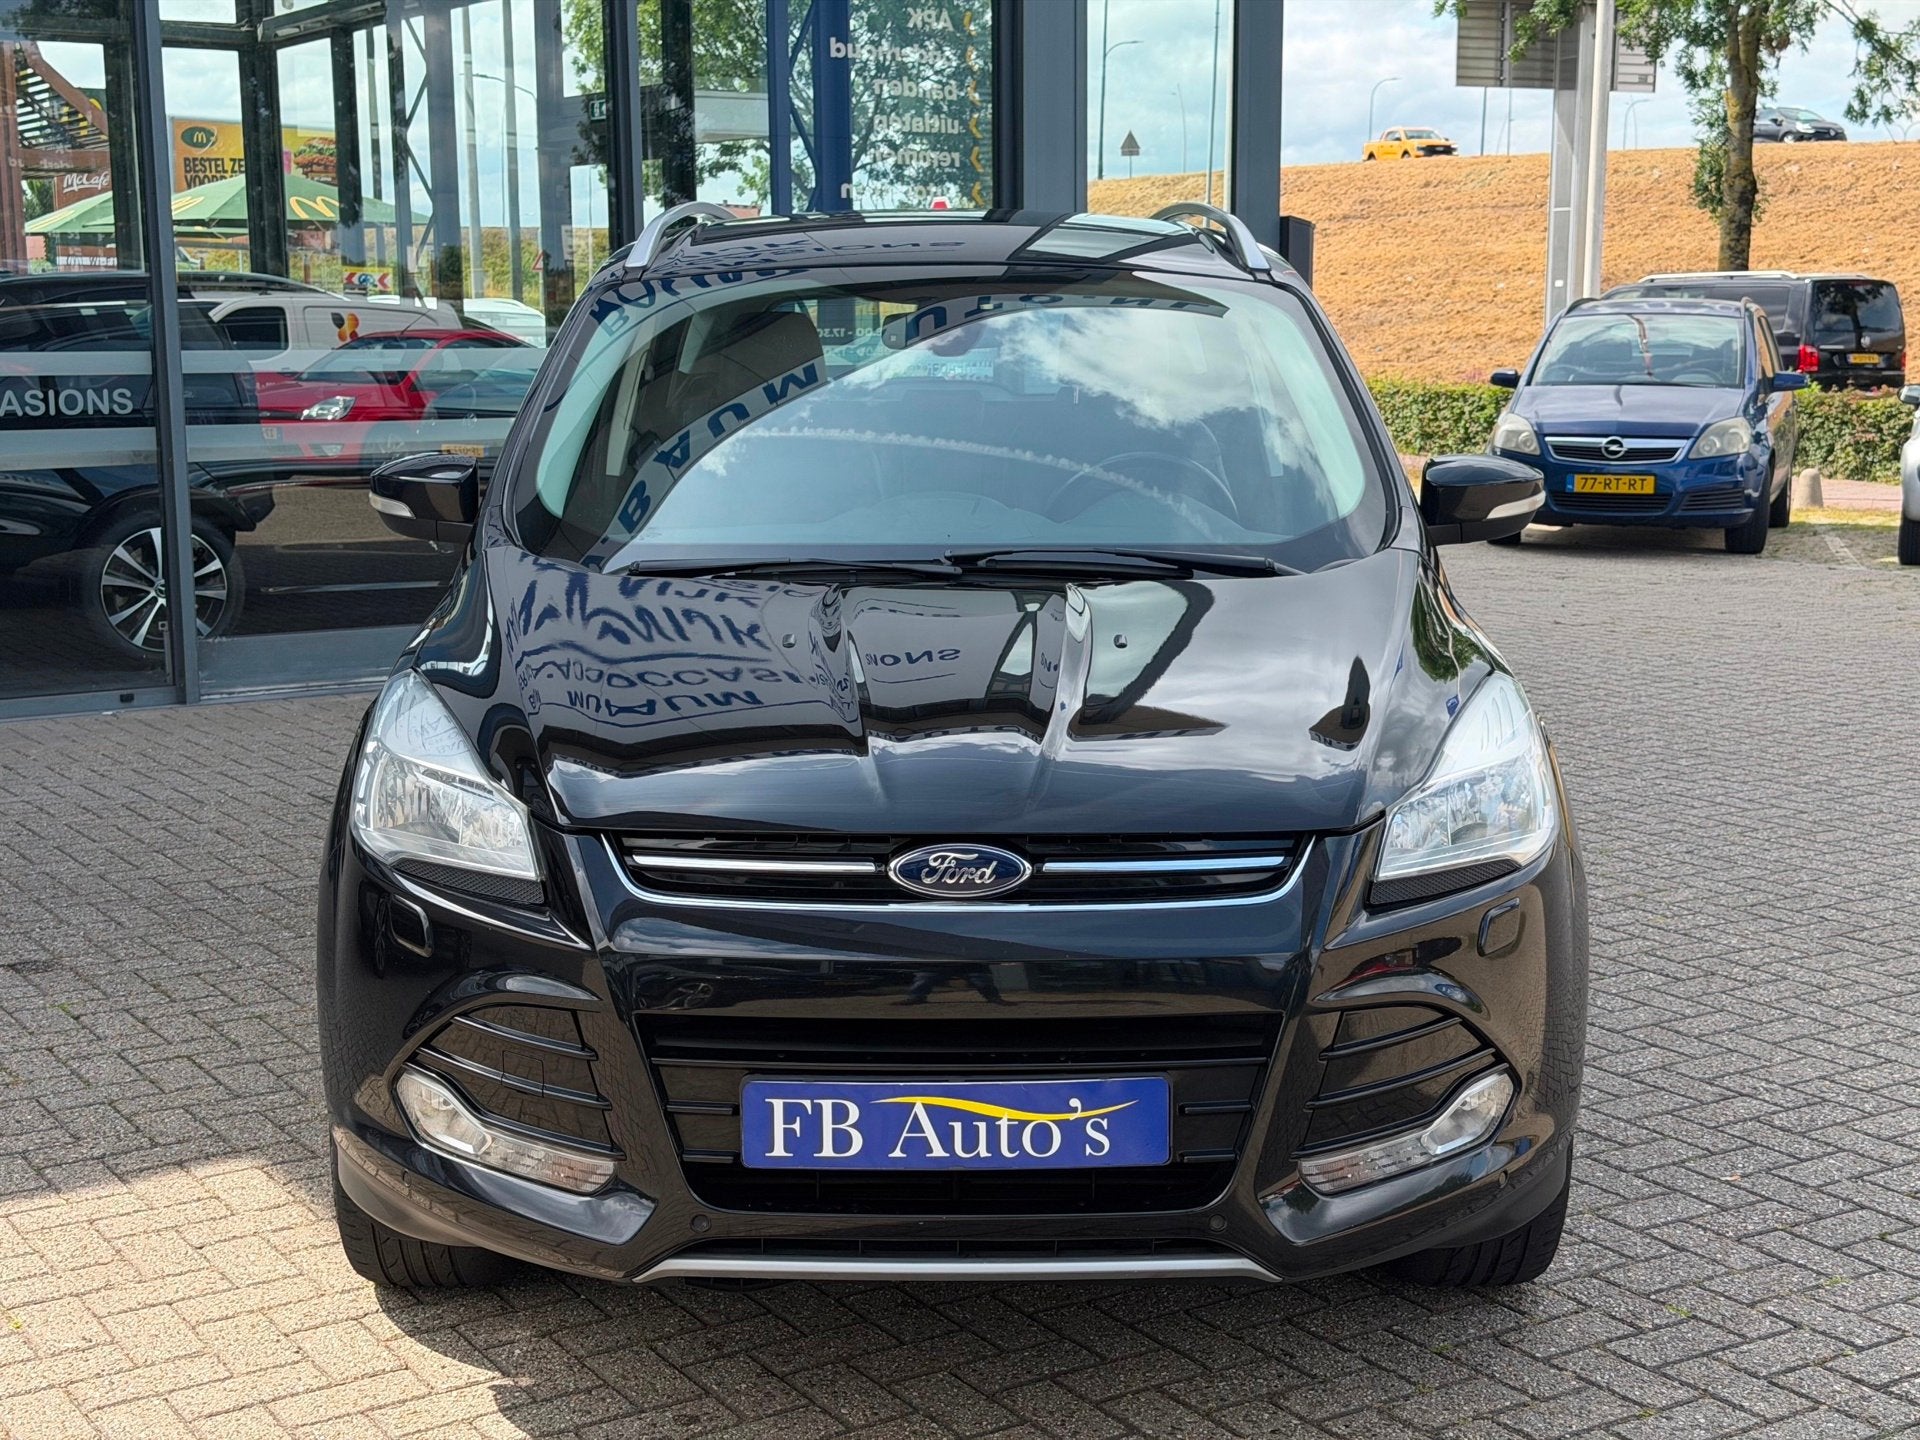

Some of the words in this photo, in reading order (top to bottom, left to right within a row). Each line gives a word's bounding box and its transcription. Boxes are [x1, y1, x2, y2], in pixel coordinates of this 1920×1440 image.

[183, 157, 229, 174] BESTEL
[0, 388, 134, 417] ASIONS
[1580, 477, 1647, 491] 77-RT-RT
[921, 852, 998, 884] Ford
[765, 1098, 863, 1157] FB
[888, 1097, 1111, 1158] Auto's
